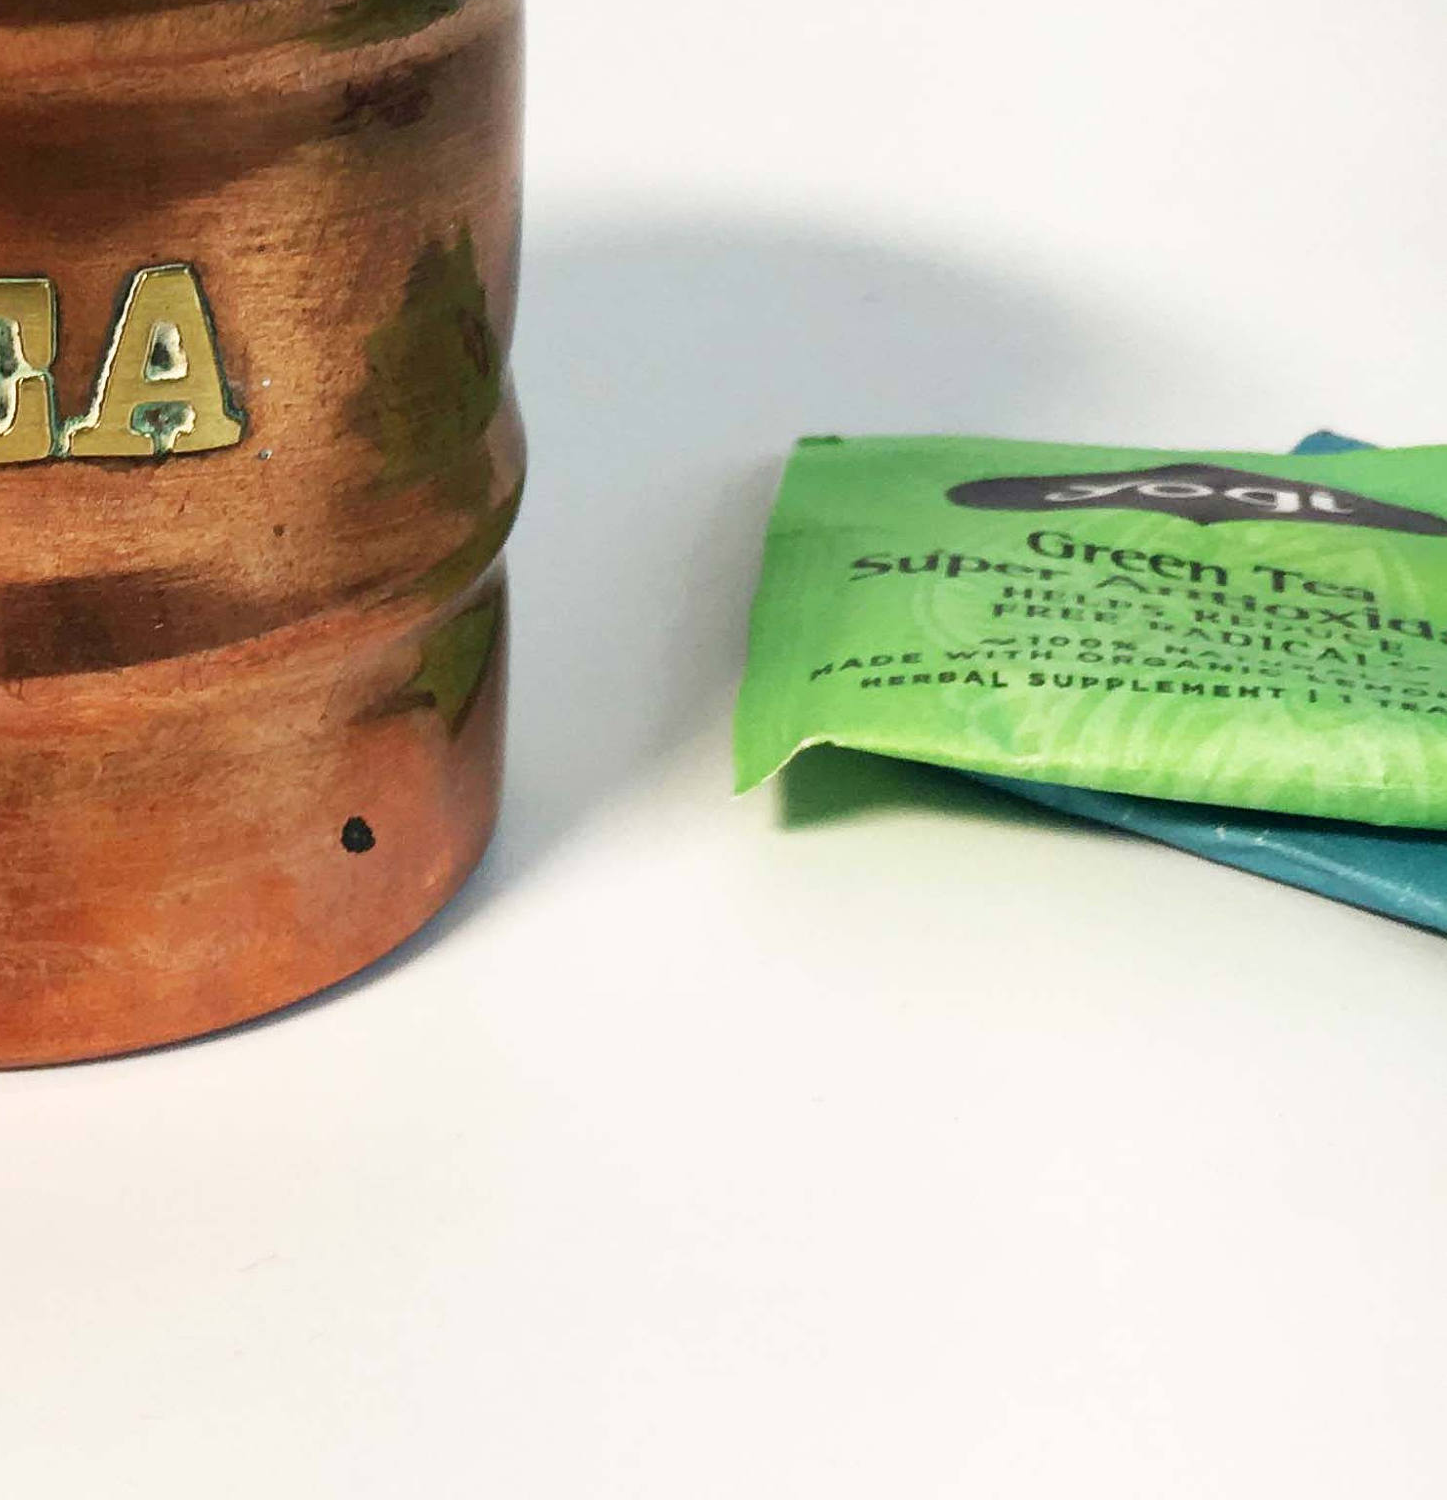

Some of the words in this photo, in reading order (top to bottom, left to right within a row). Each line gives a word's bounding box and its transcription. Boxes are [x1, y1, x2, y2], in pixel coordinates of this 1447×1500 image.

[1043, 480, 1354, 514] yogi
[848, 548, 1071, 581] Super
[1026, 530, 1229, 587] Green
[1252, 564, 1376, 602] Tea
[992, 602, 1120, 625] FREE
[810, 652, 922, 681] MADE
[945, 649, 1053, 661] WITH
[1076, 651, 1282, 678] ORGANIC
[860, 670, 1008, 689] HERBAL
[1027, 672, 1286, 699] SUPPLEMENT
